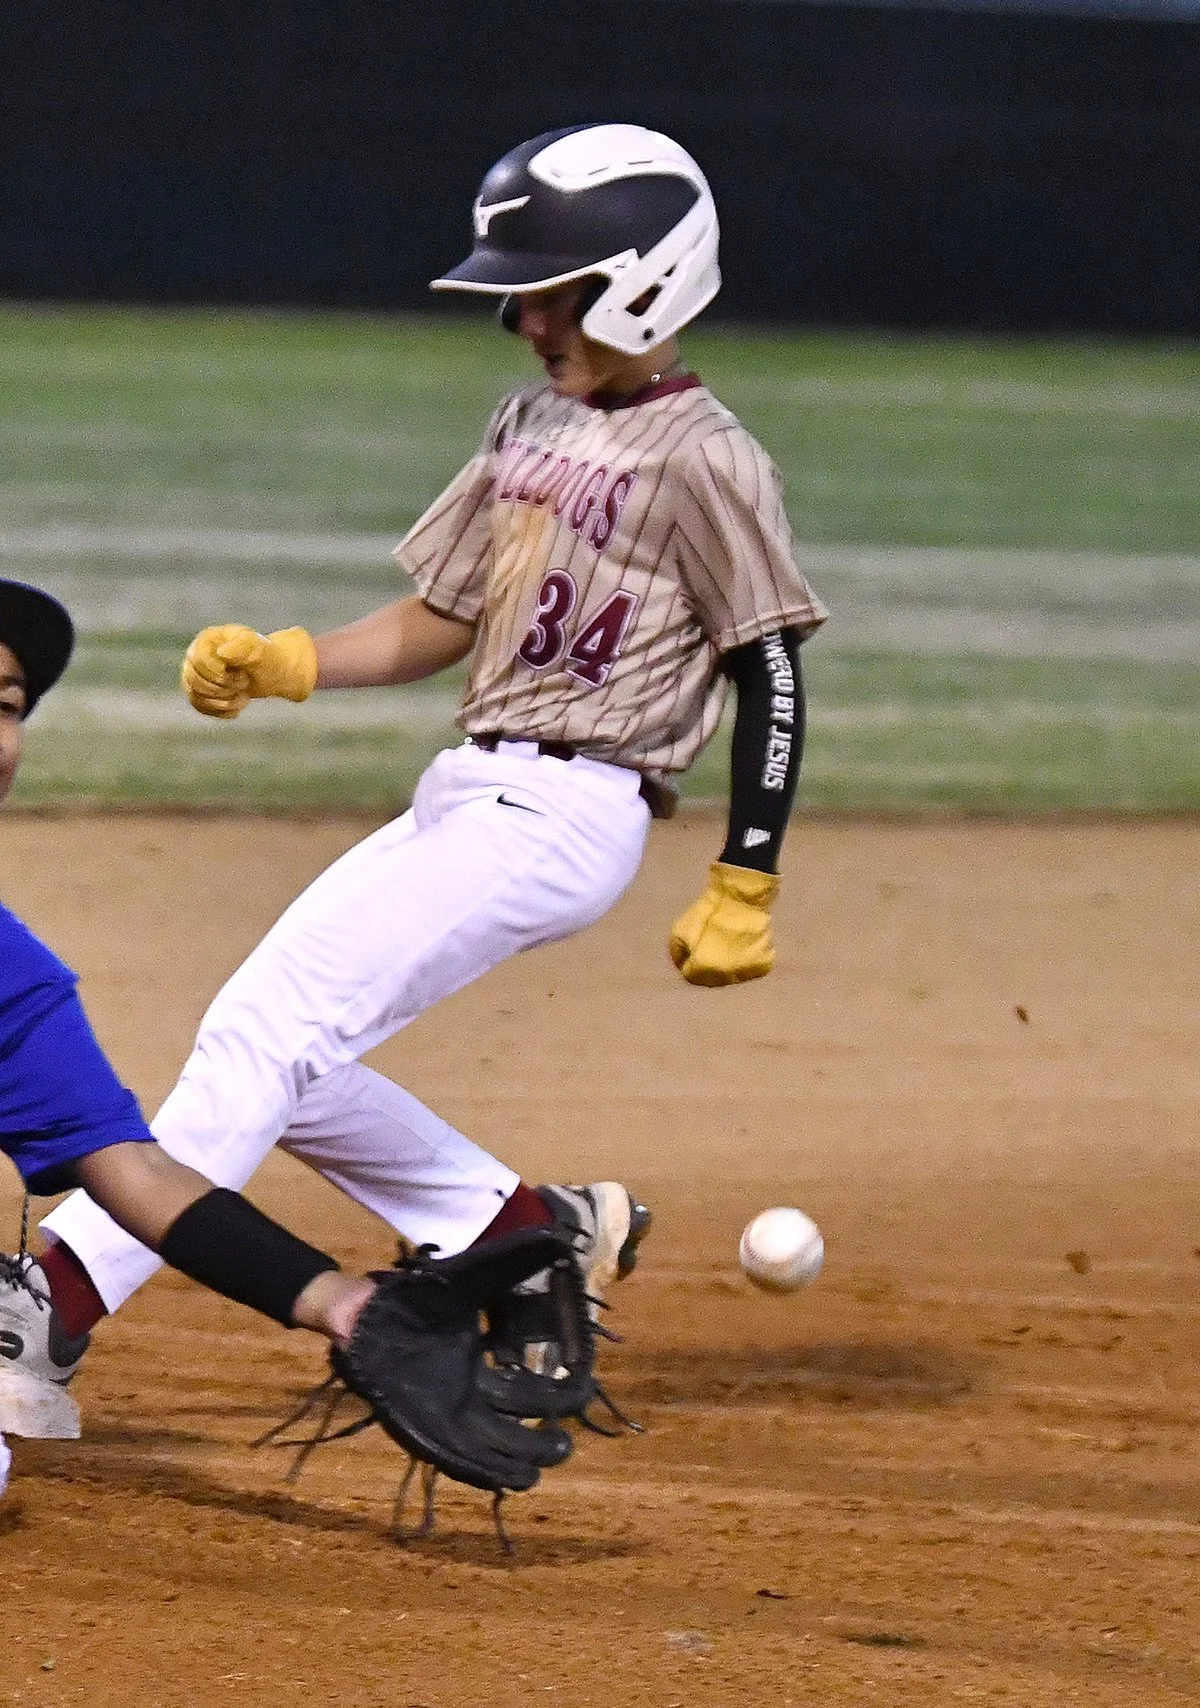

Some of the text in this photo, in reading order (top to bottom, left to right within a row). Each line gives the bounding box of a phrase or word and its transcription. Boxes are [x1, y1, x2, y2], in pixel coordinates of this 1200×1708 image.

[518, 567, 638, 688] 34
[769, 694, 795, 725] BY
[760, 725, 793, 791] JESUS
